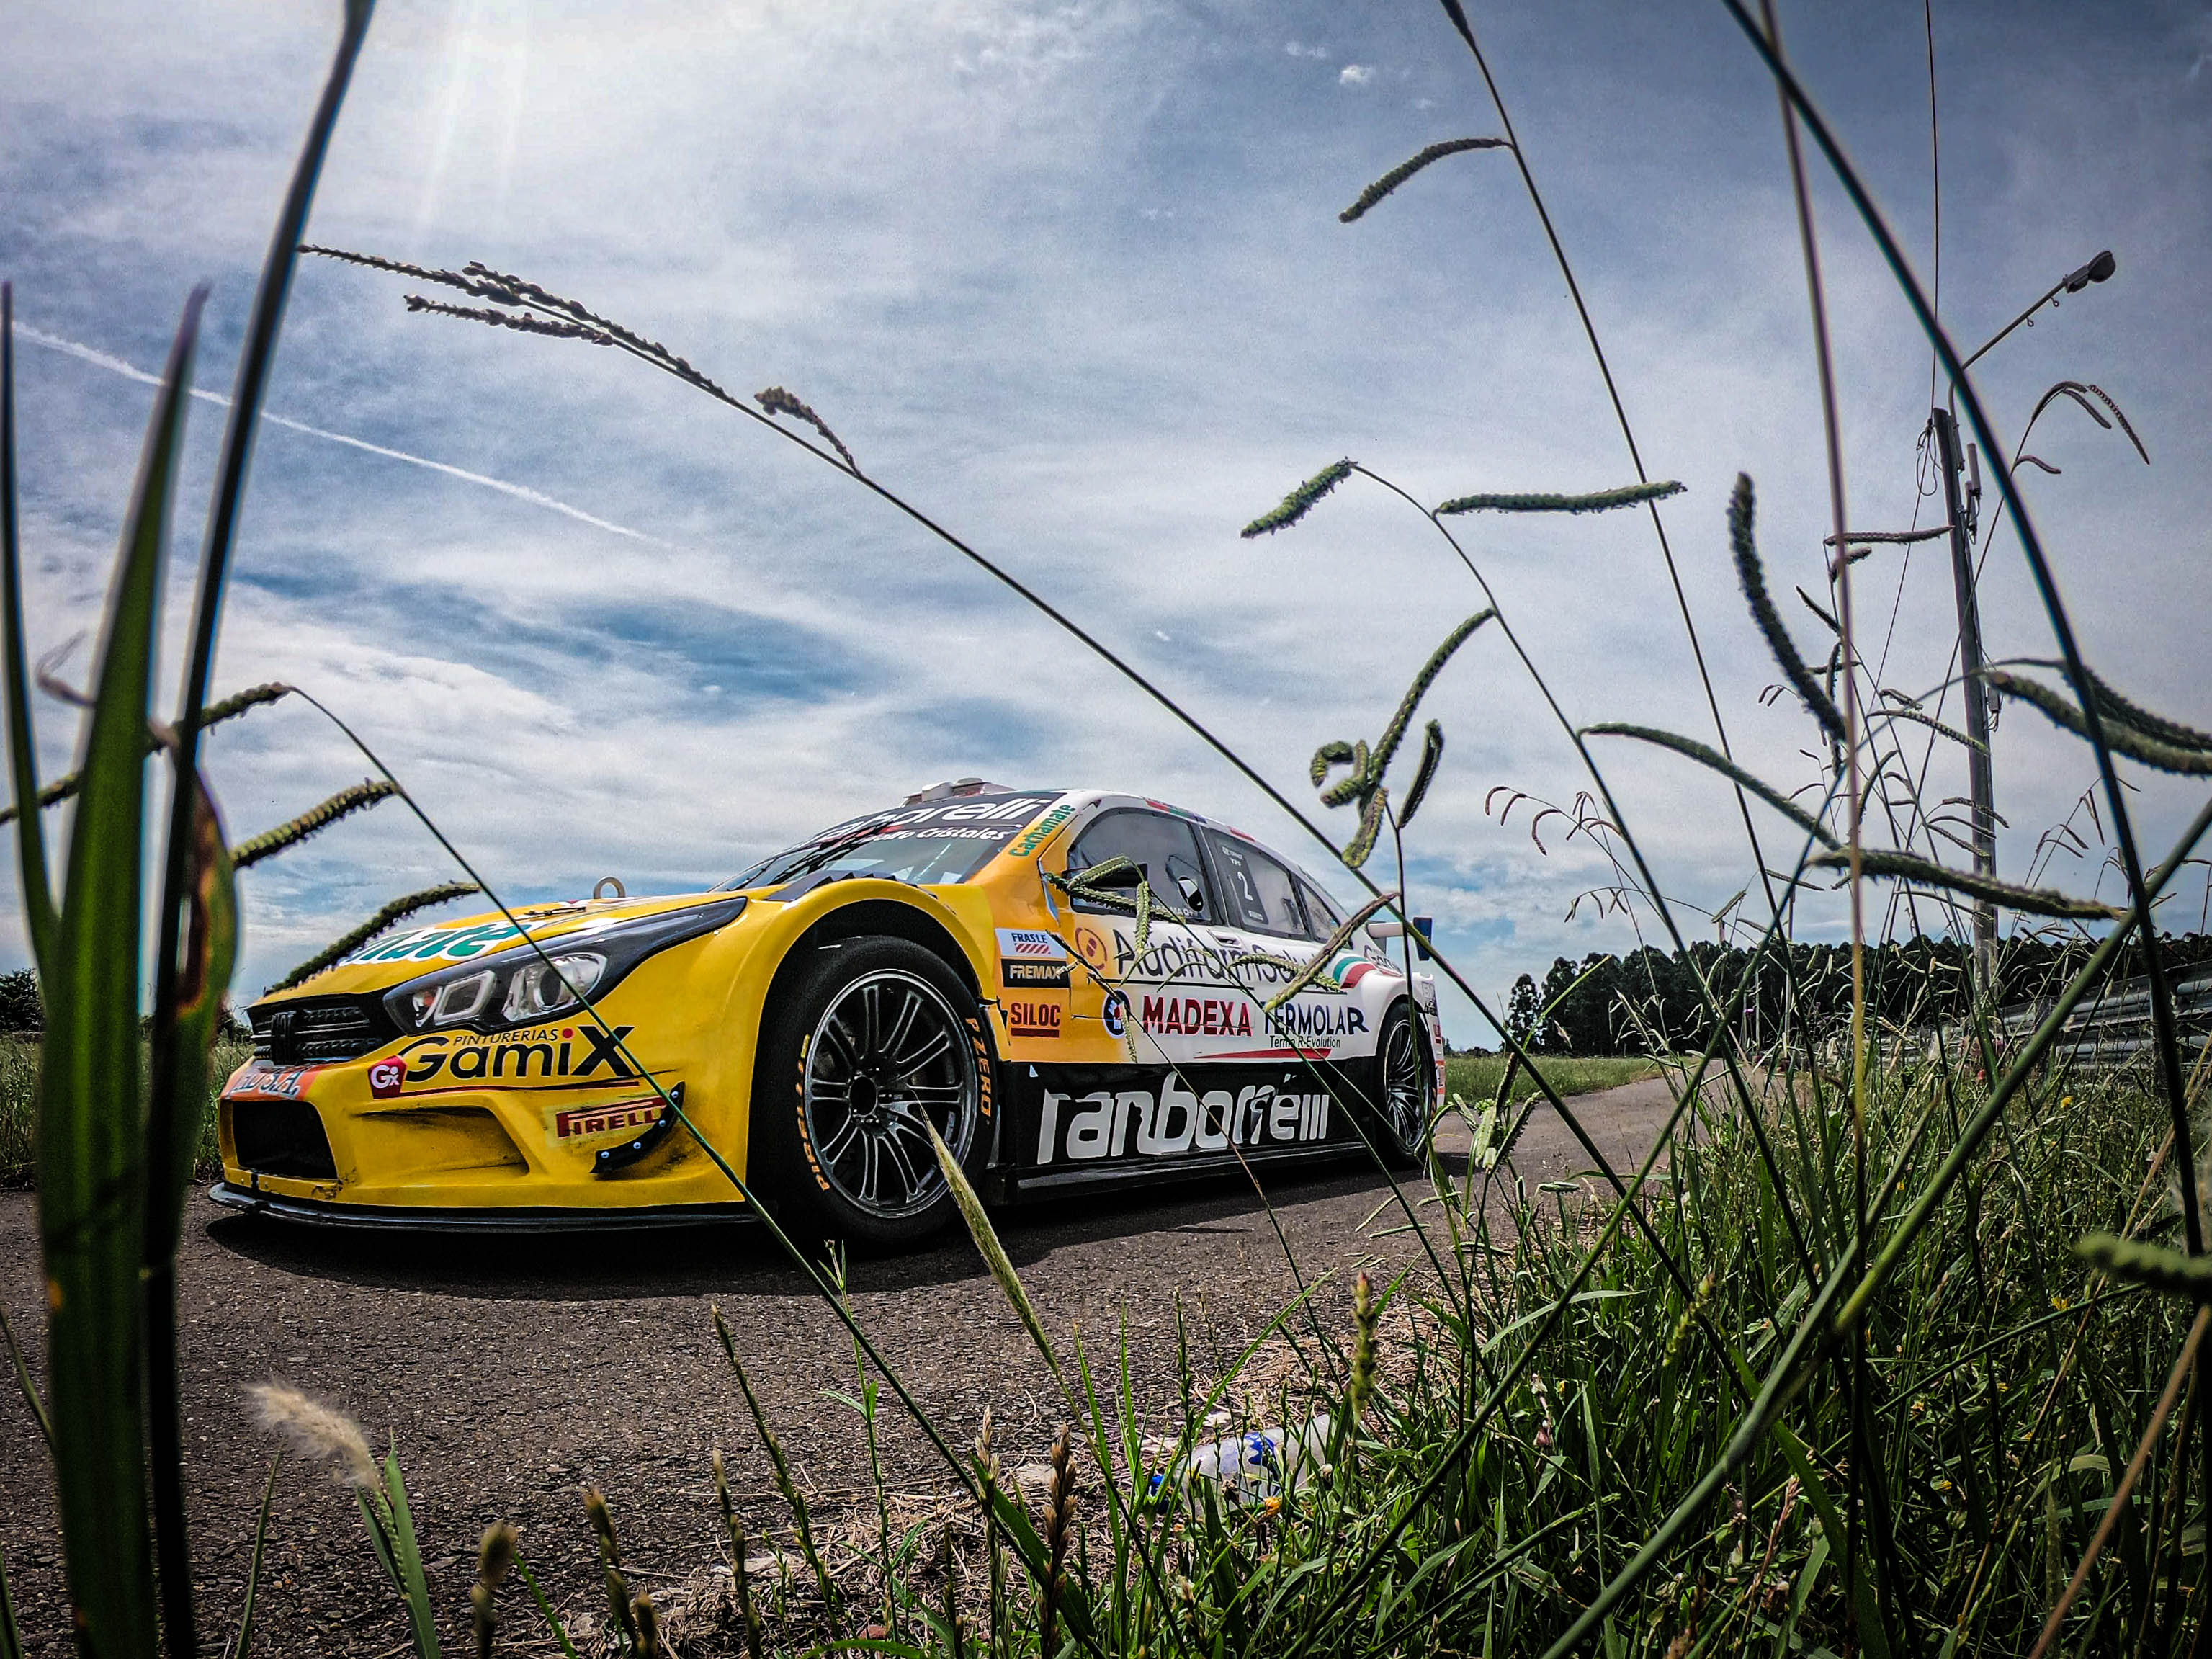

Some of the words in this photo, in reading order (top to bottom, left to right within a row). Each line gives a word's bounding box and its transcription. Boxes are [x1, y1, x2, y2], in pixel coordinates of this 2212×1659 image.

[916, 826, 1010, 841] Cristales
[1009, 805, 1075, 857] Cachamate
[1237, 871, 1253, 900] 2
[1009, 965, 1061, 980] FREMAX
[1011, 1002, 1061, 1027] SILOC
[1142, 995, 1252, 1037] MADEXA
[1261, 1001, 1370, 1036] TERMOLAR
[397, 1025, 635, 1082] GamiX
[453, 1028, 560, 1046] PINTURERIAS
[972, 1037, 992, 1117] ZERO
[557, 1096, 668, 1138] PIRELL
